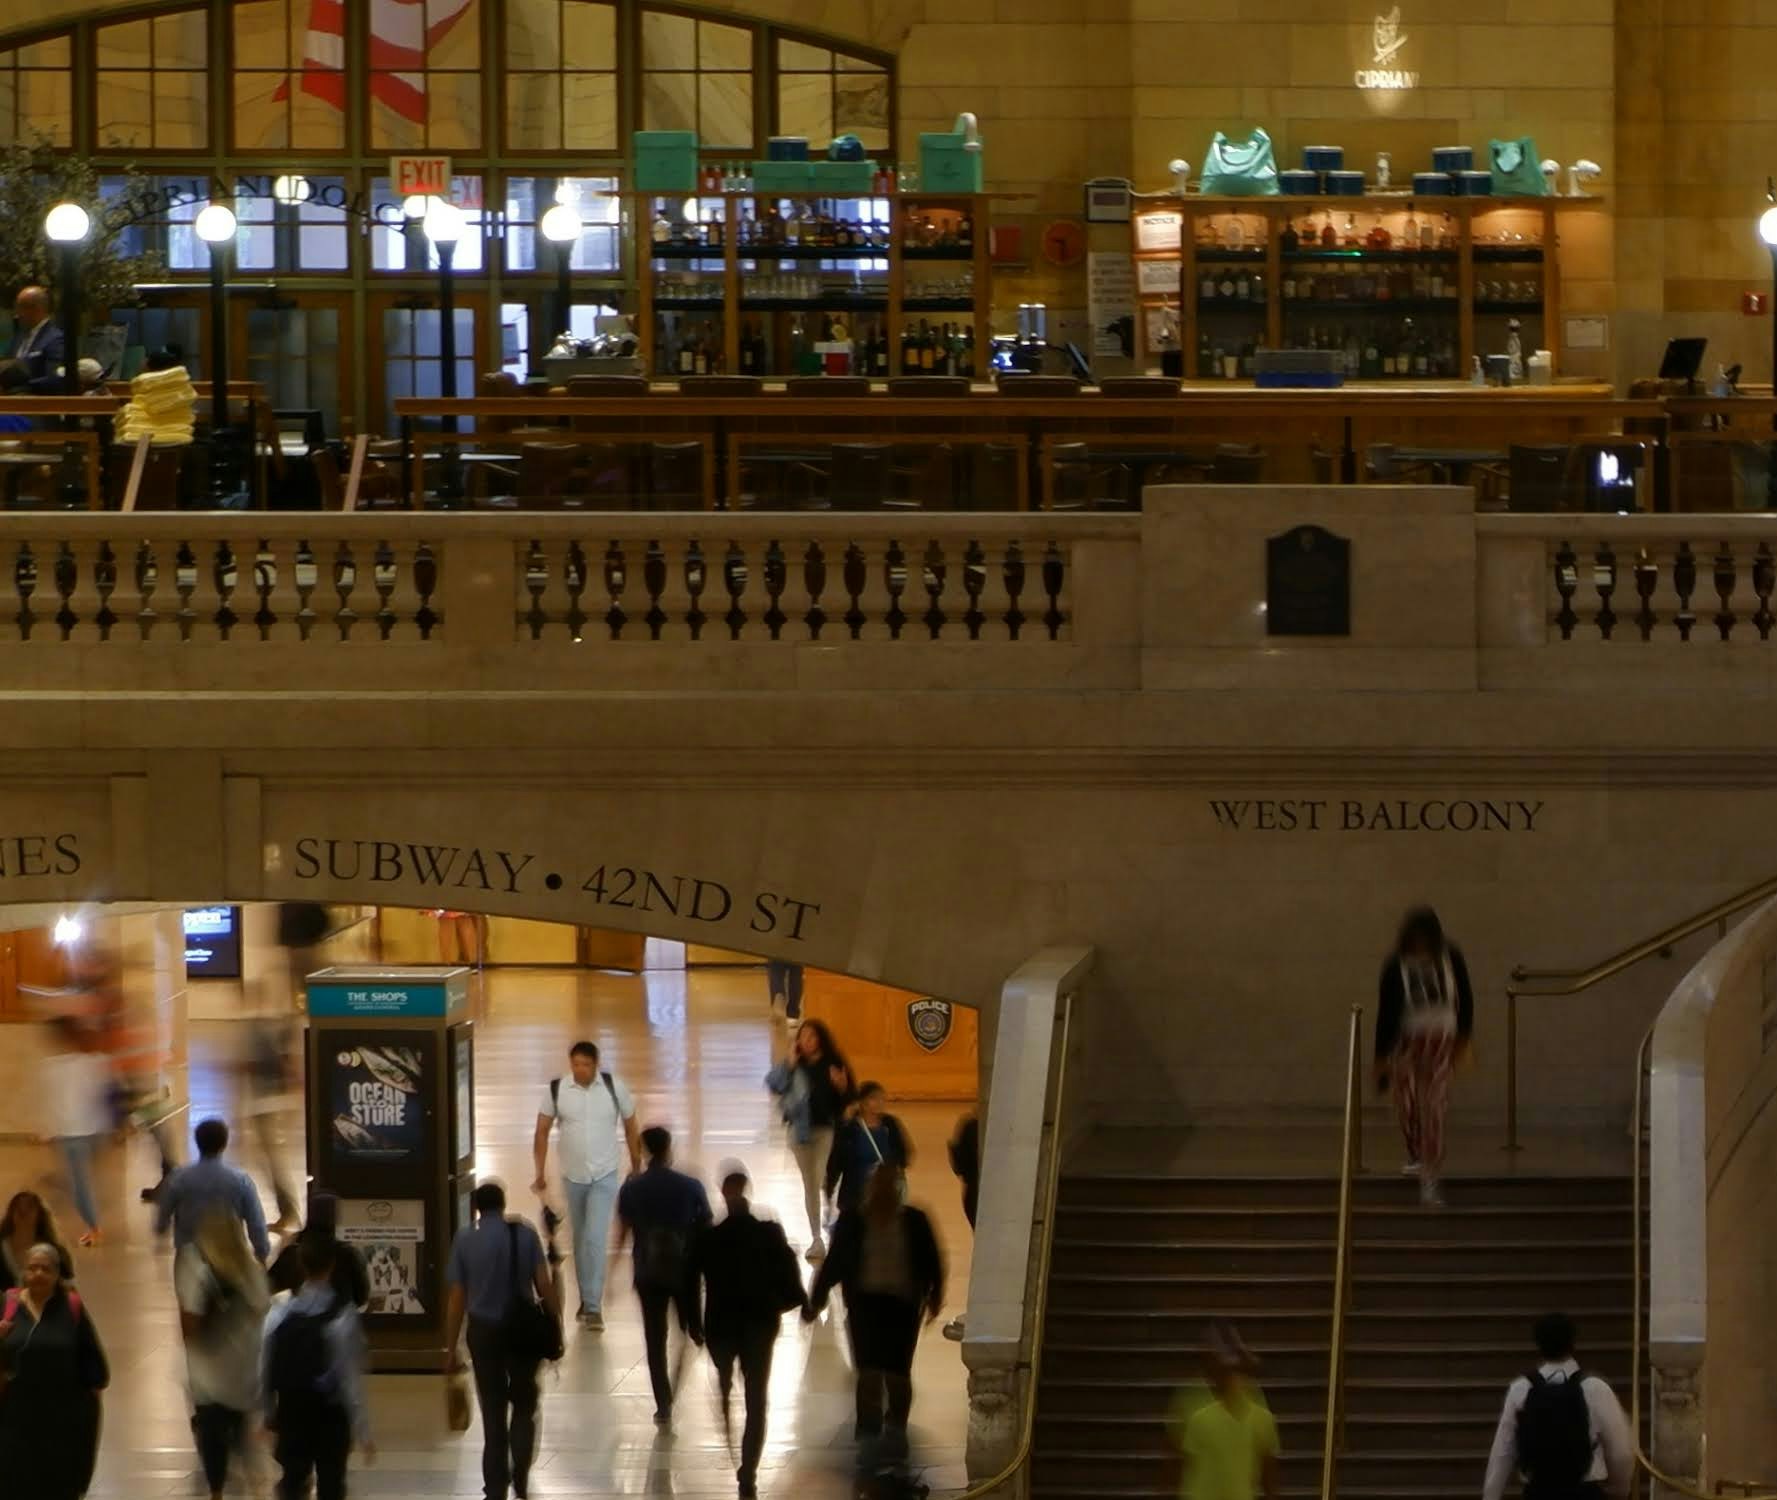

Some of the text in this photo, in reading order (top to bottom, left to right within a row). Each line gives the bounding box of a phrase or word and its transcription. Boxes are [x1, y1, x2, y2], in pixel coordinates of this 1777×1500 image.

[401, 160, 445, 193] EXIT
[1209, 799, 1544, 832] WEST BALCONY
[0, 834, 80, 876] ES
[294, 838, 821, 940] SUBWAY 42ND ST
[347, 991, 408, 1001] THE SHOPS
[912, 1000, 949, 1014] POLICE
[349, 1082, 406, 1104] OCEAN
[351, 1104, 406, 1127] STORE
